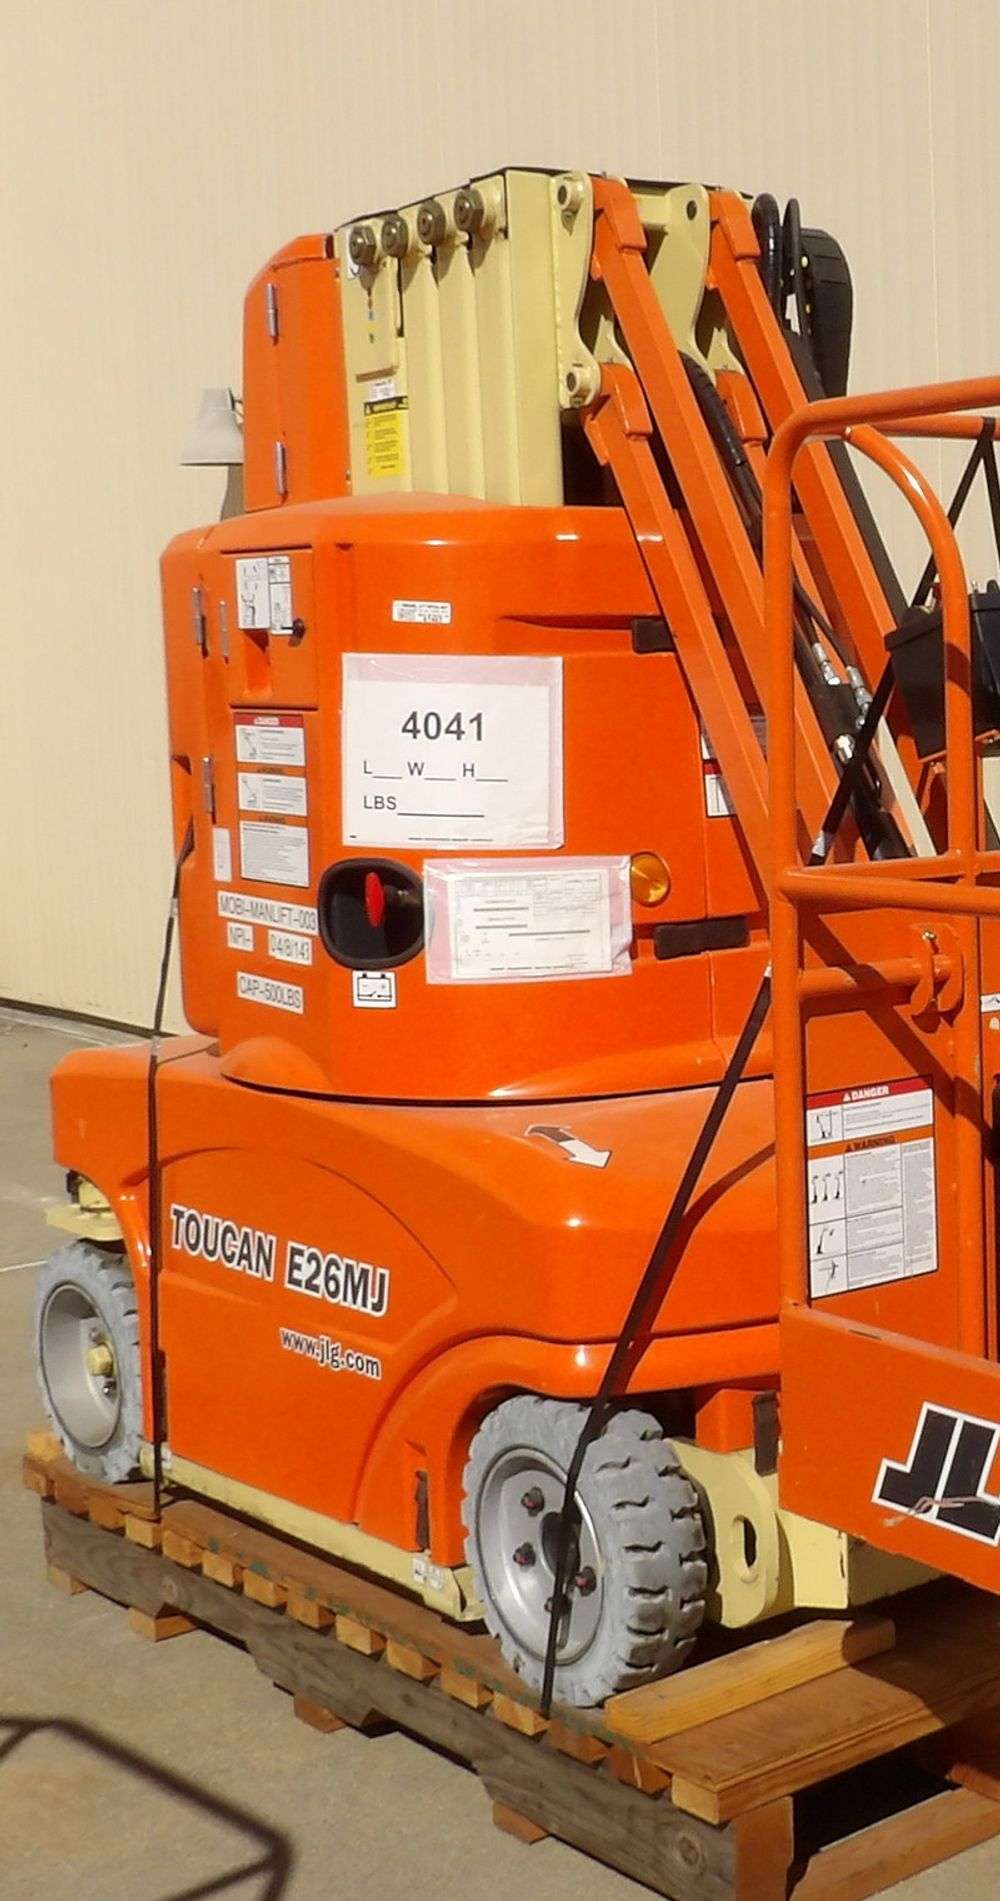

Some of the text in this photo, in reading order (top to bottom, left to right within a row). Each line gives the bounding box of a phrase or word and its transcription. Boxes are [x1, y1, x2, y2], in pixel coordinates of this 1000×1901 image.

[401, 711, 483, 742] 4041
[851, 1086, 890, 1100] DANGER
[171, 1204, 389, 1315] TOUCAN E26MJ
[280, 1329, 381, 1379] www.jlg.com
